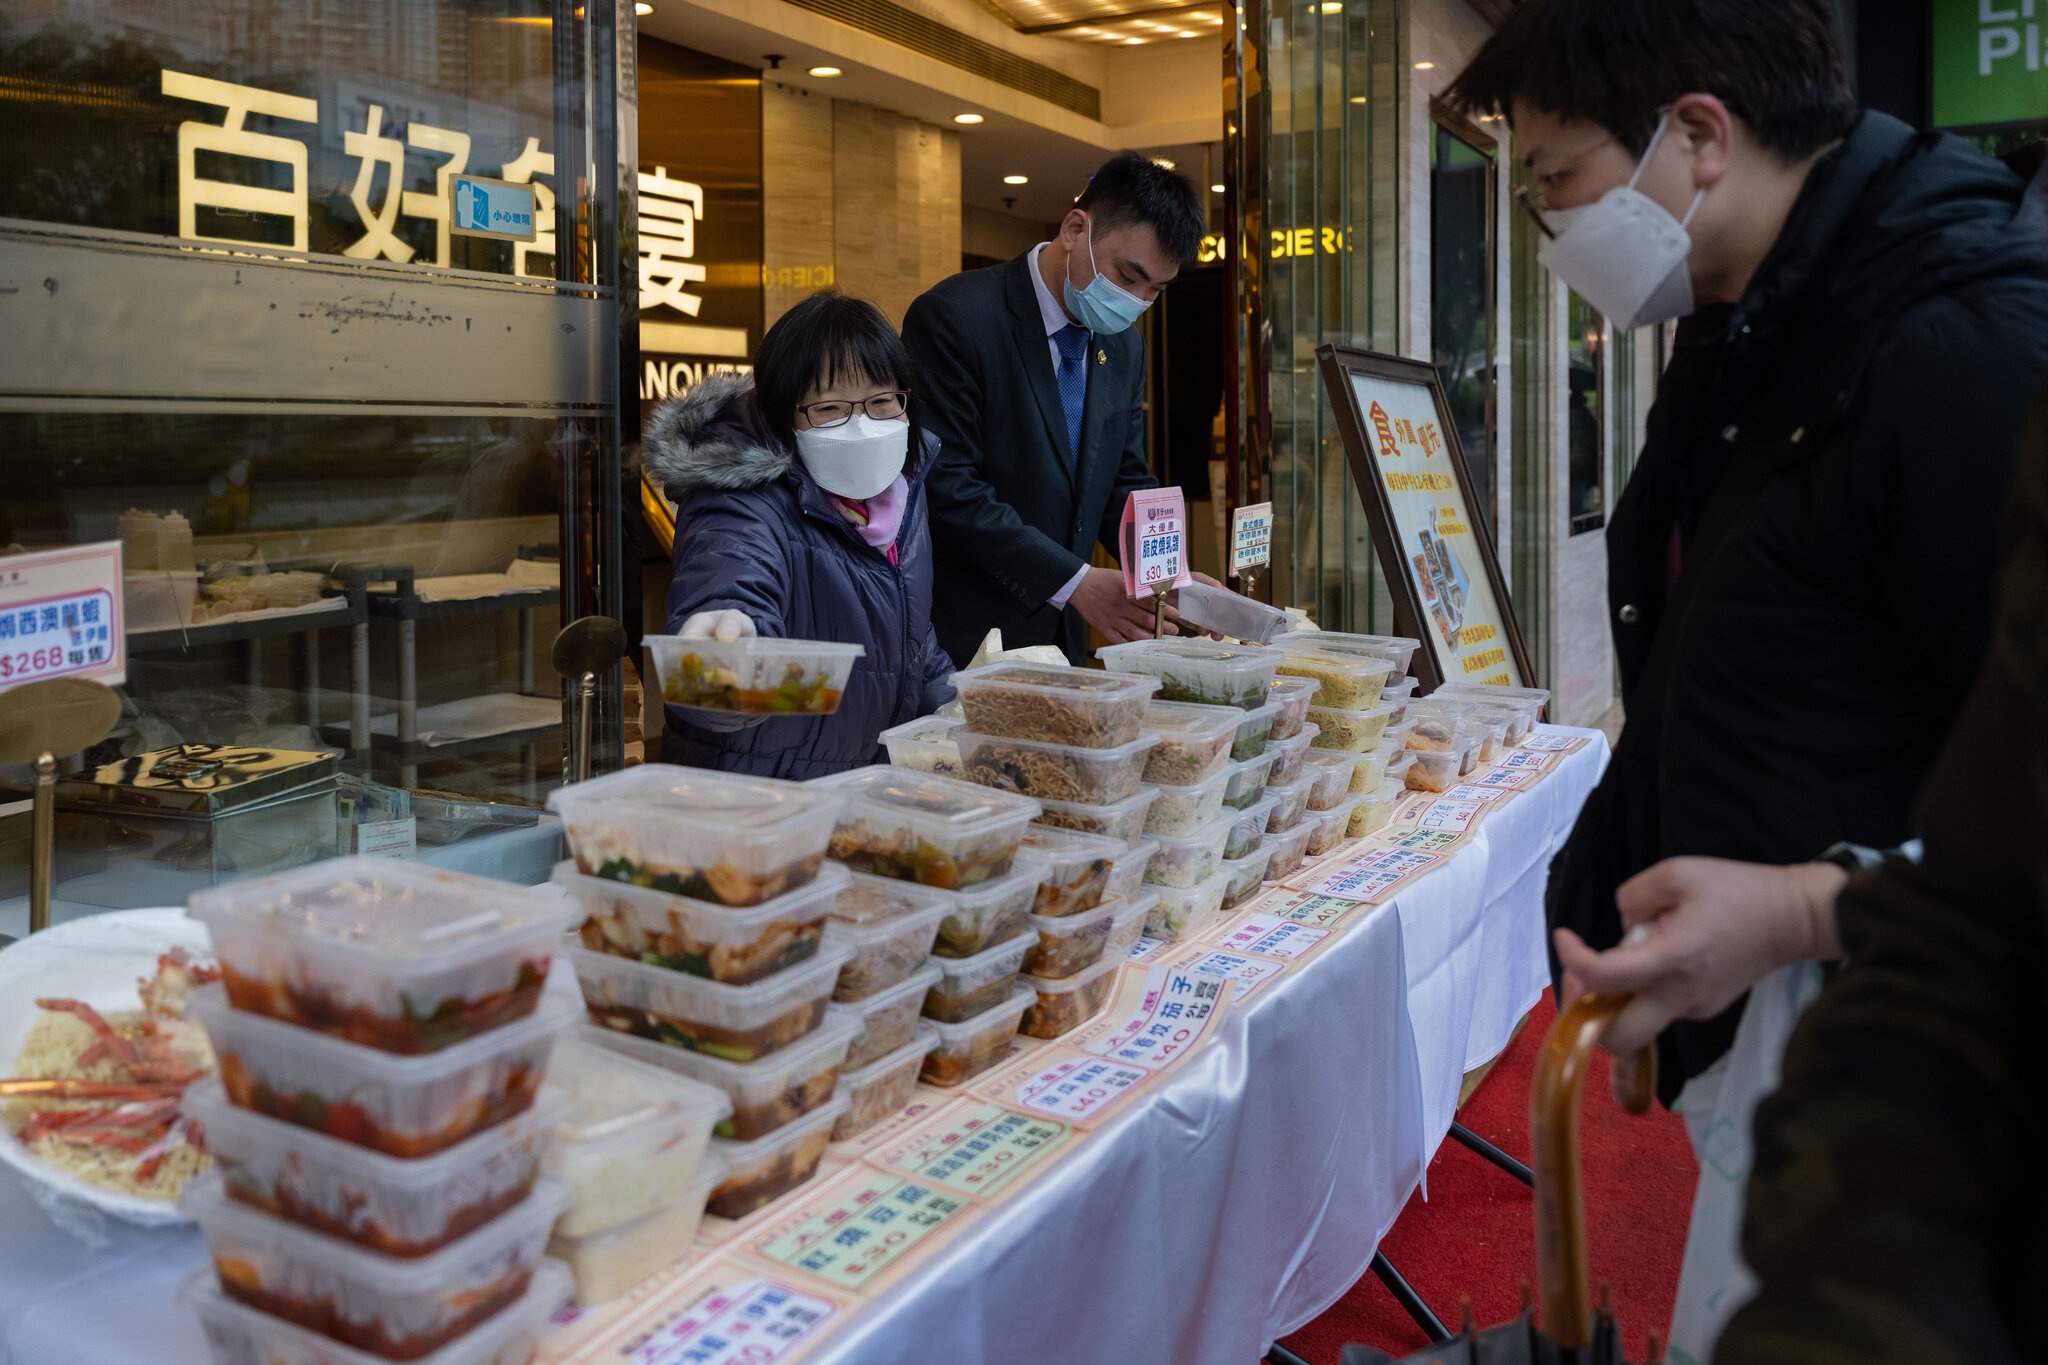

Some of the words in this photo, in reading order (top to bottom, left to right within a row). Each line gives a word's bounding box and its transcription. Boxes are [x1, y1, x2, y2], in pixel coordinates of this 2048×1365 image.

[1979, 24, 2048, 76] Pl
[494, 210, 531, 226] 小心玻璃
[1146, 565, 1161, 580] $30
[0, 646, 63, 677] $268
[1222, 924, 1266, 949] 大優惠
[1107, 990, 1159, 1046] 大優惠
[1152, 1029, 1190, 1061] $40
[1023, 1064, 1074, 1094] 大優惠
[1070, 1088, 1107, 1112] $40
[919, 1119, 983, 1160] 大優惠
[965, 1151, 1013, 1184] $30
[792, 1189, 878, 1244] 大優惠
[798, 1185, 930, 1271] 紅燒豆腐
[844, 1230, 907, 1274] $30
